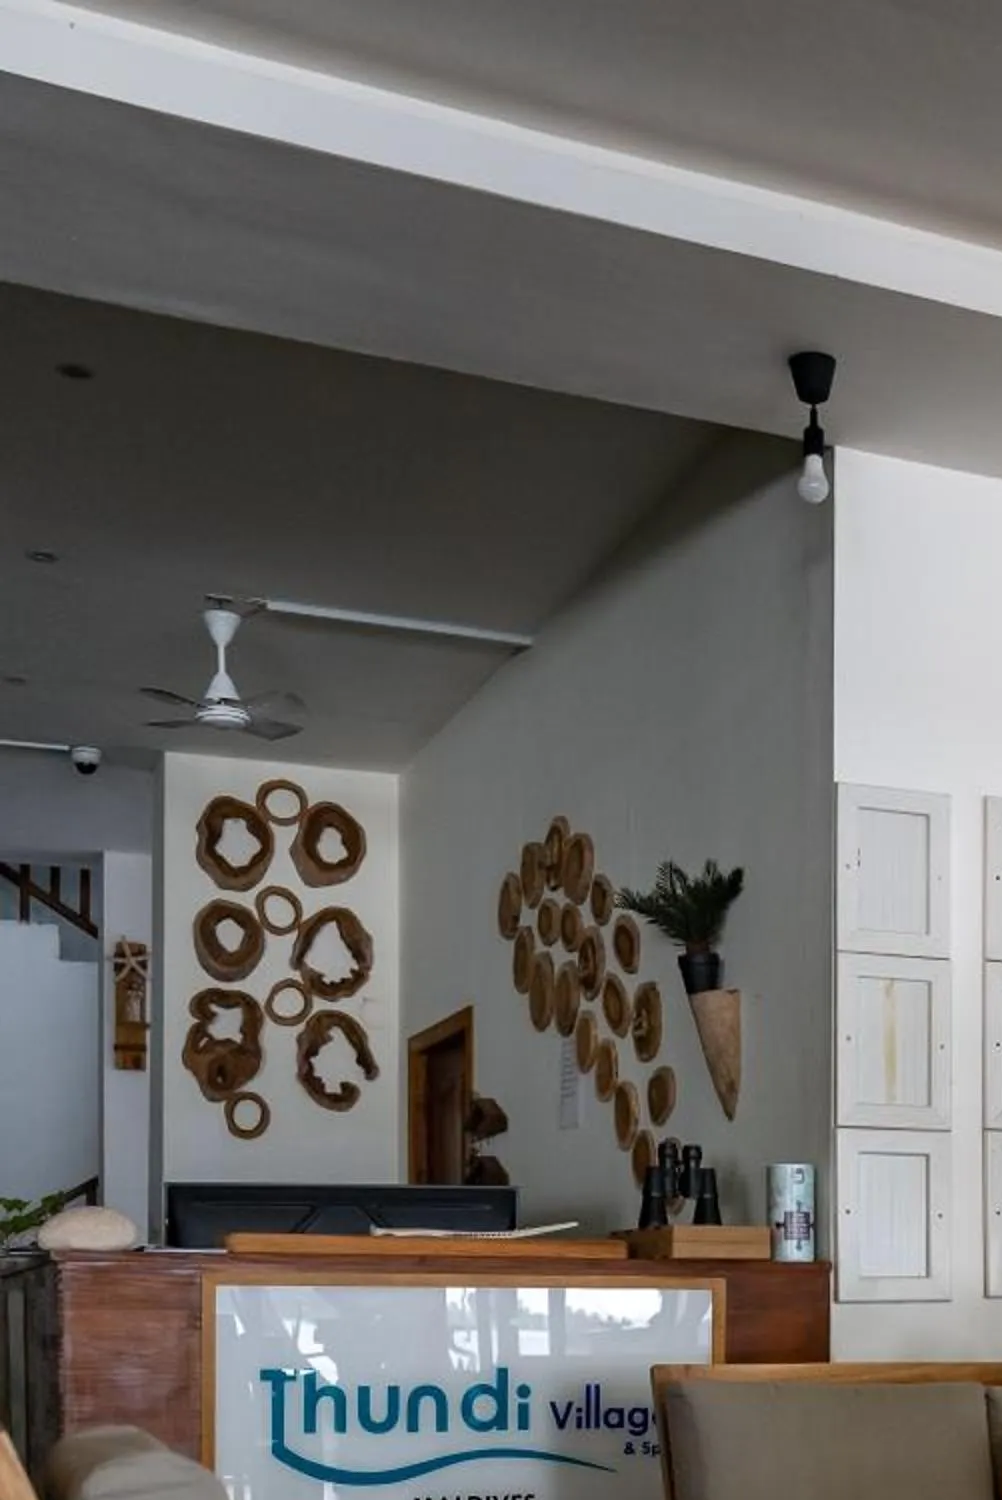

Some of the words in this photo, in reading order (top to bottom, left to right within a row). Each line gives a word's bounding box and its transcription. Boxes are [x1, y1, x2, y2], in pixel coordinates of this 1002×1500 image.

[260, 1367, 531, 1453] Thundi
[549, 1383, 656, 1436] Villag
[623, 1441, 635, 1455] &
[641, 1441, 661, 1457] Sp
